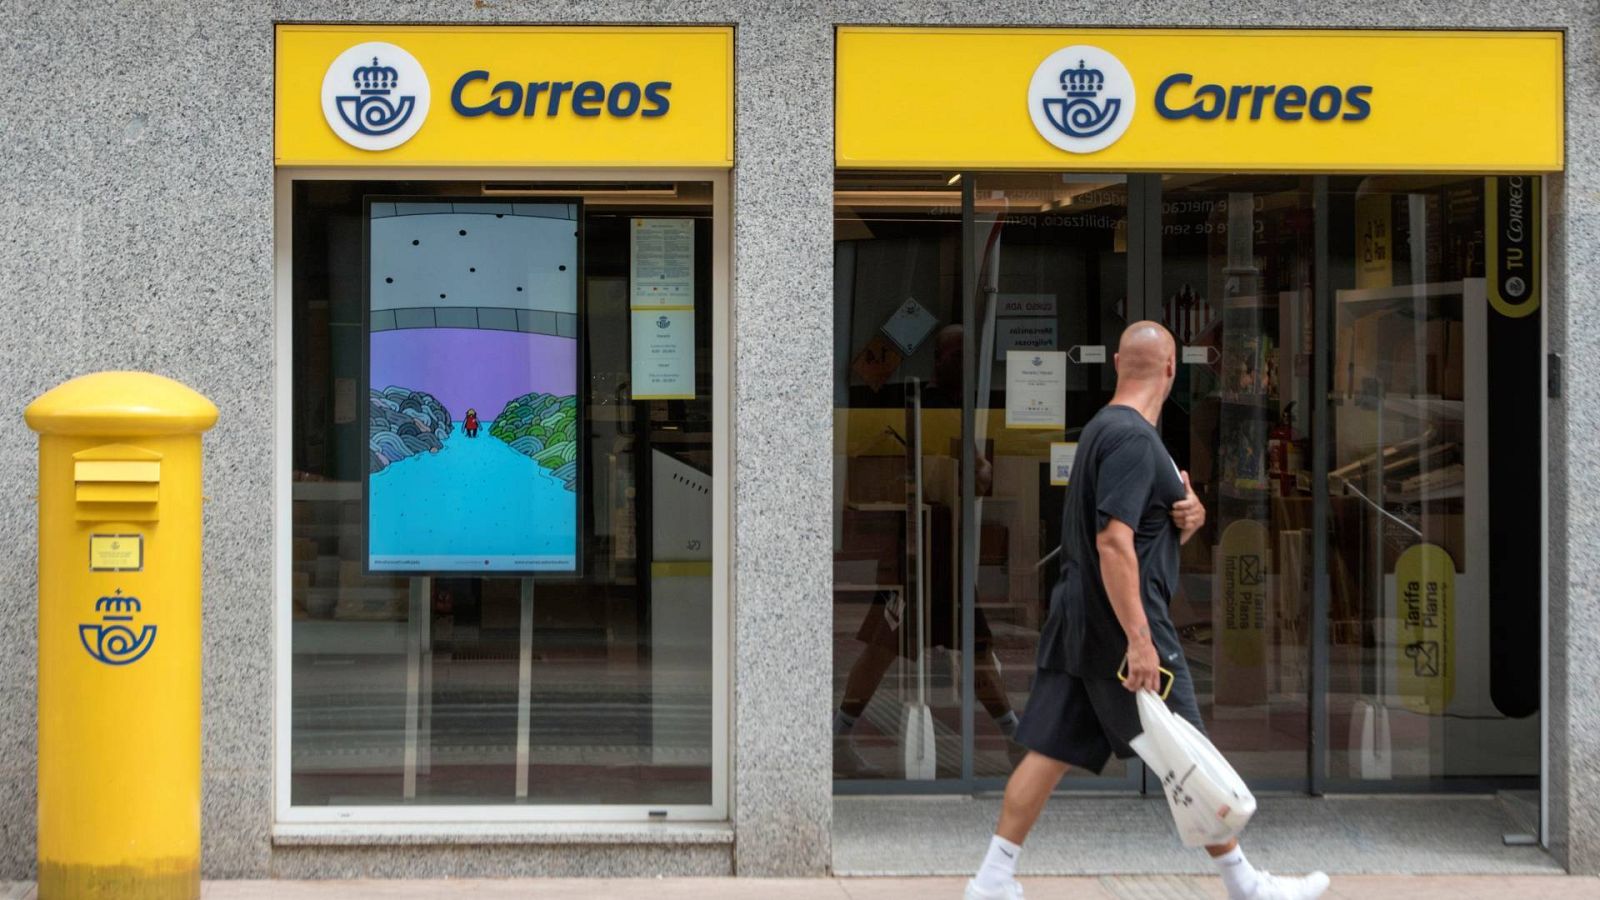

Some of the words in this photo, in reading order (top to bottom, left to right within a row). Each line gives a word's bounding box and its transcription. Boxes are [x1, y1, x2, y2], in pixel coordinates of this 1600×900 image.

[451, 70, 672, 118] Correos
[1154, 73, 1373, 122] Correos
[1507, 247, 1524, 271] TU
[1225, 555, 1238, 630] Internacional
[1239, 592, 1251, 629] Plana
[1403, 581, 1420, 630] Tarifa
[1423, 581, 1438, 629] Plana
